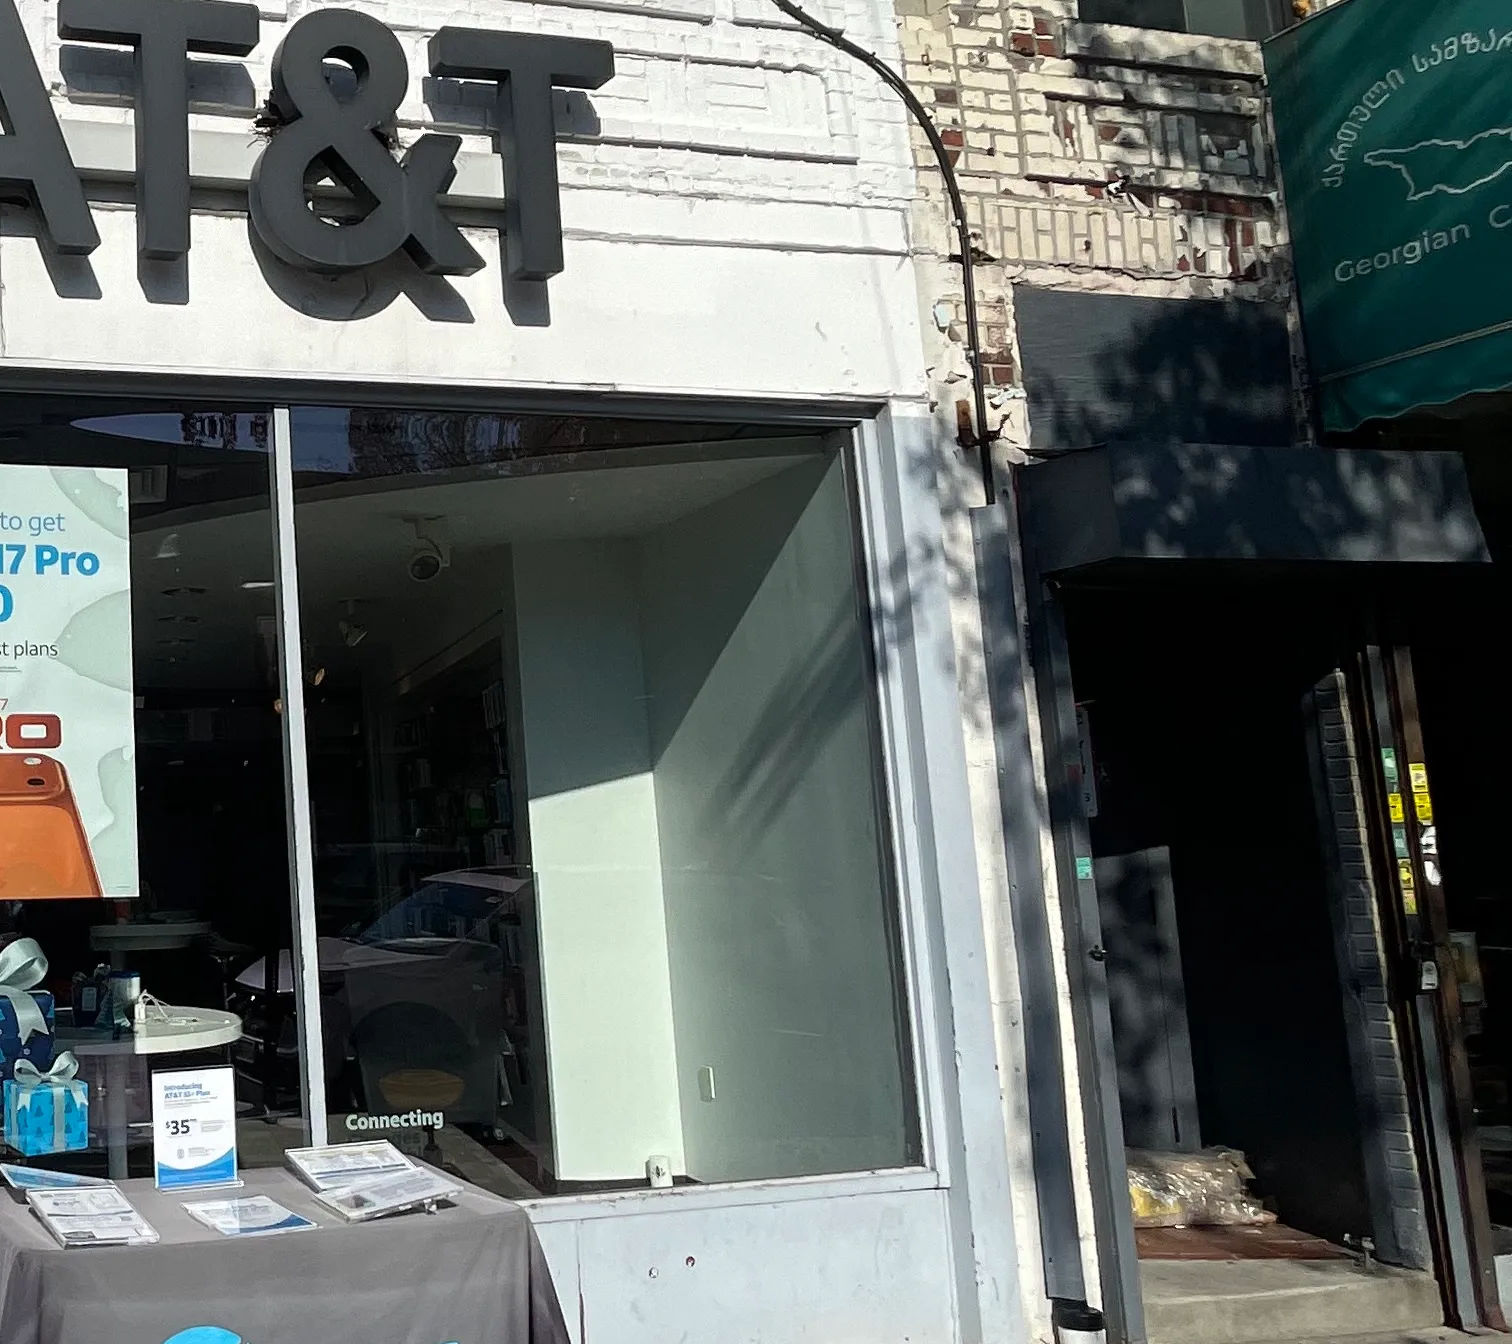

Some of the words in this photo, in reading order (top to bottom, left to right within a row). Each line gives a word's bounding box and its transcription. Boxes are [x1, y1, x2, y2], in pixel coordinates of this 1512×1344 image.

[1334, 223, 1471, 282] Georgian
[0, 511, 22, 531] to
[28, 513, 66, 537] get
[34, 544, 100, 577] Pro
[14, 640, 59, 660] plans
[345, 1108, 444, 1130] Connecting
